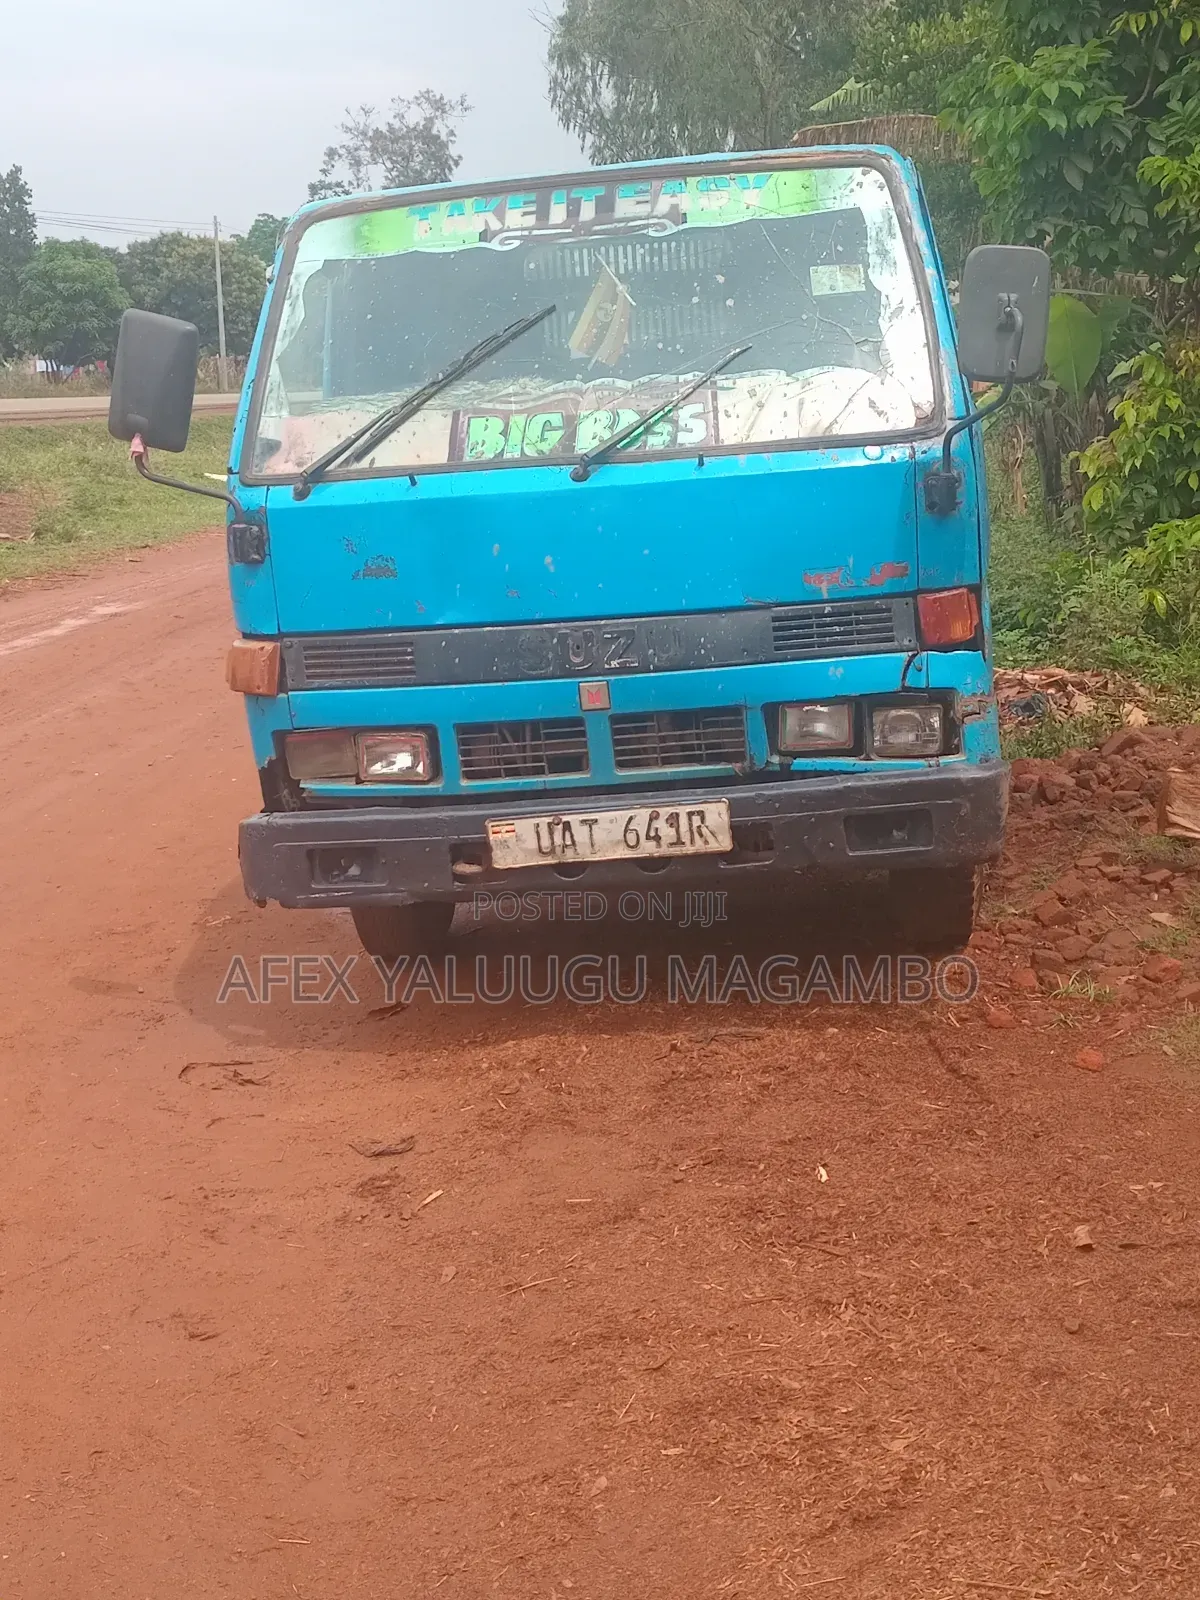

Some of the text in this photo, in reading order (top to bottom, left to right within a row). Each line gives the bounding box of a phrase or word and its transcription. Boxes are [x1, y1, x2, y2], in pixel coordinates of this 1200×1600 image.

[408, 173, 773, 237] TAKE IT EASY
[465, 411, 565, 460] BIG
[534, 809, 720, 856] UAT 641R
